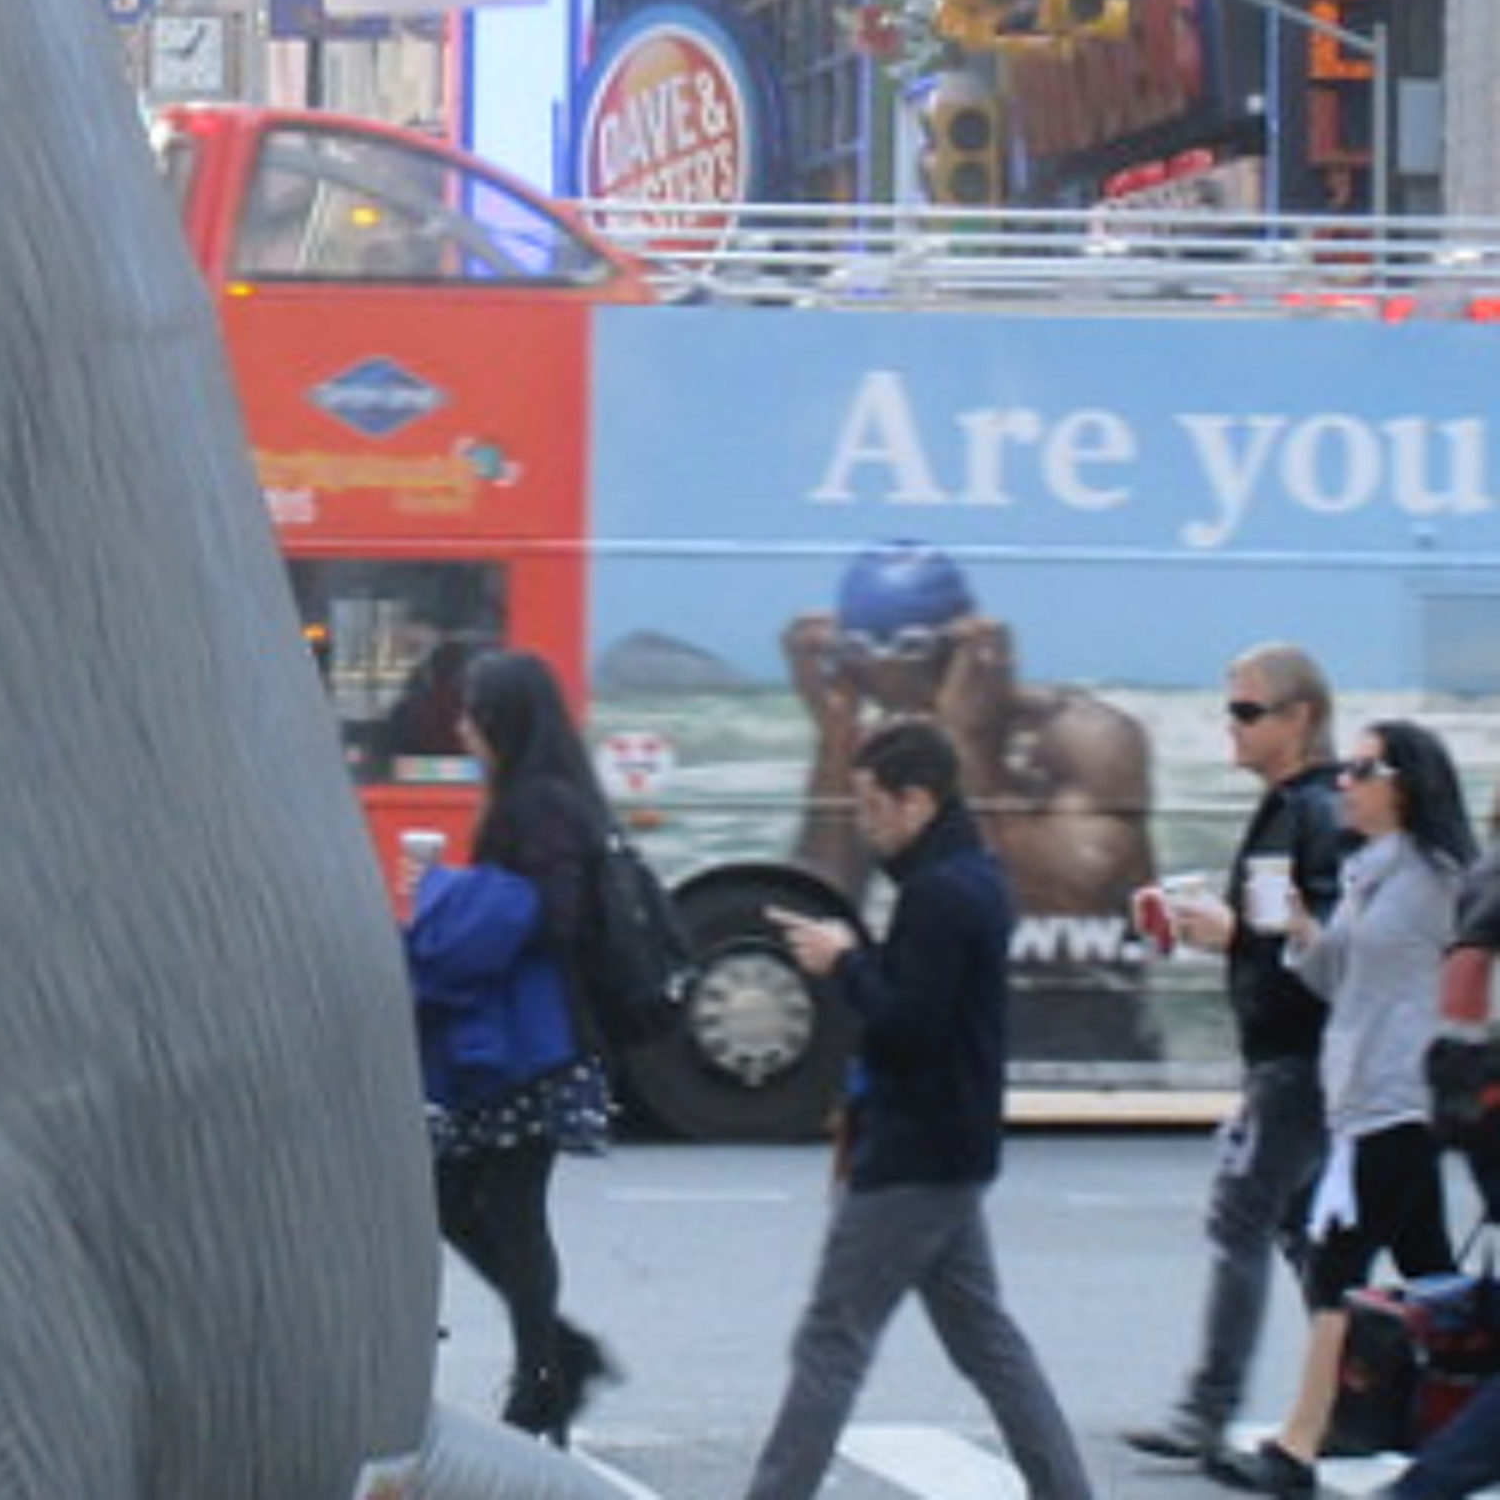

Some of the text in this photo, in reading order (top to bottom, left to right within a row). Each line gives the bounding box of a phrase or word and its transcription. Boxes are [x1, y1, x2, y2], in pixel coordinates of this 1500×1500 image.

[601, 69, 728, 180] DAVE &
[806, 369, 1500, 548] Are you
